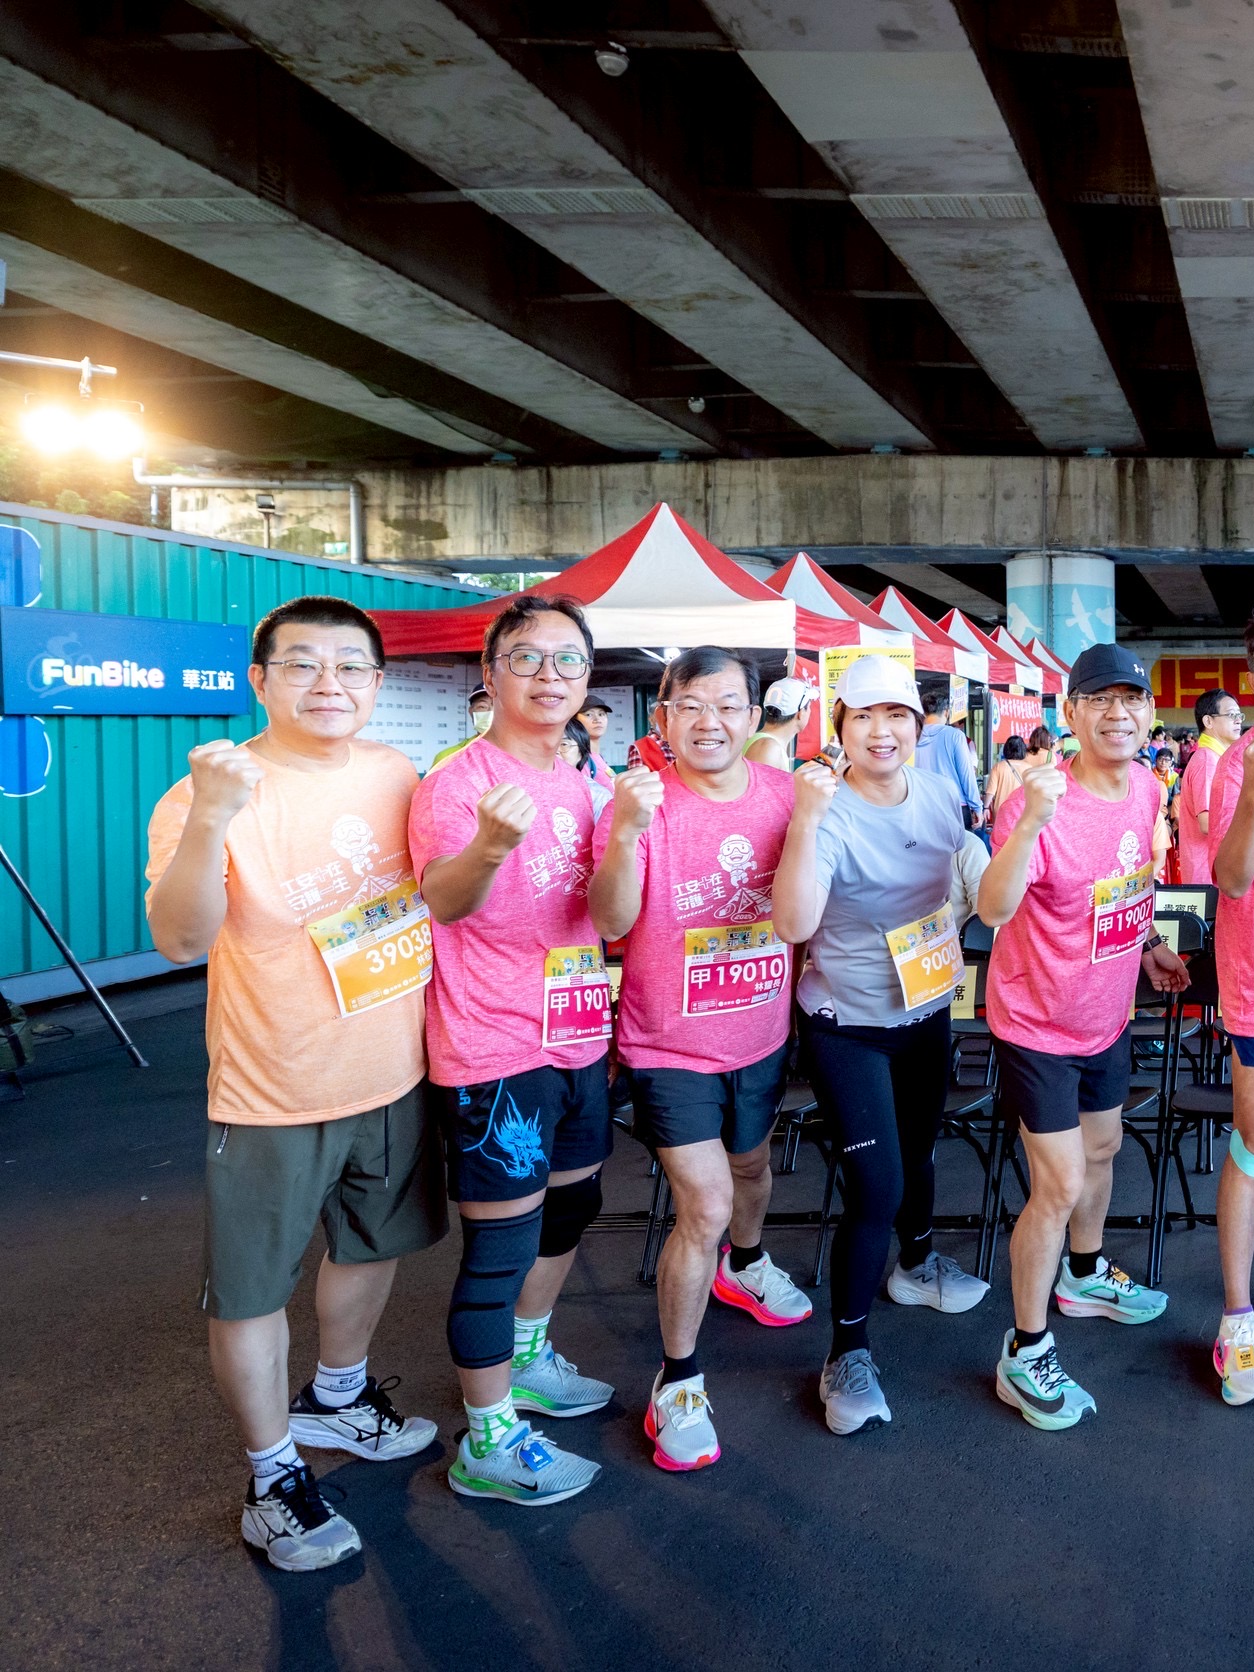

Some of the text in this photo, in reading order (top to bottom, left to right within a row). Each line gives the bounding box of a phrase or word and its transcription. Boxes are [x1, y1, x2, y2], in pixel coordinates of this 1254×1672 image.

[41, 657, 165, 689] FunBike
[182, 668, 235, 691] 華江站
[904, 840, 917, 849] alo
[1098, 896, 1153, 937] 甲19007
[365, 922, 433, 975] 39038
[690, 957, 784, 990] 甲19010
[550, 987, 610, 1017] 甲1901
